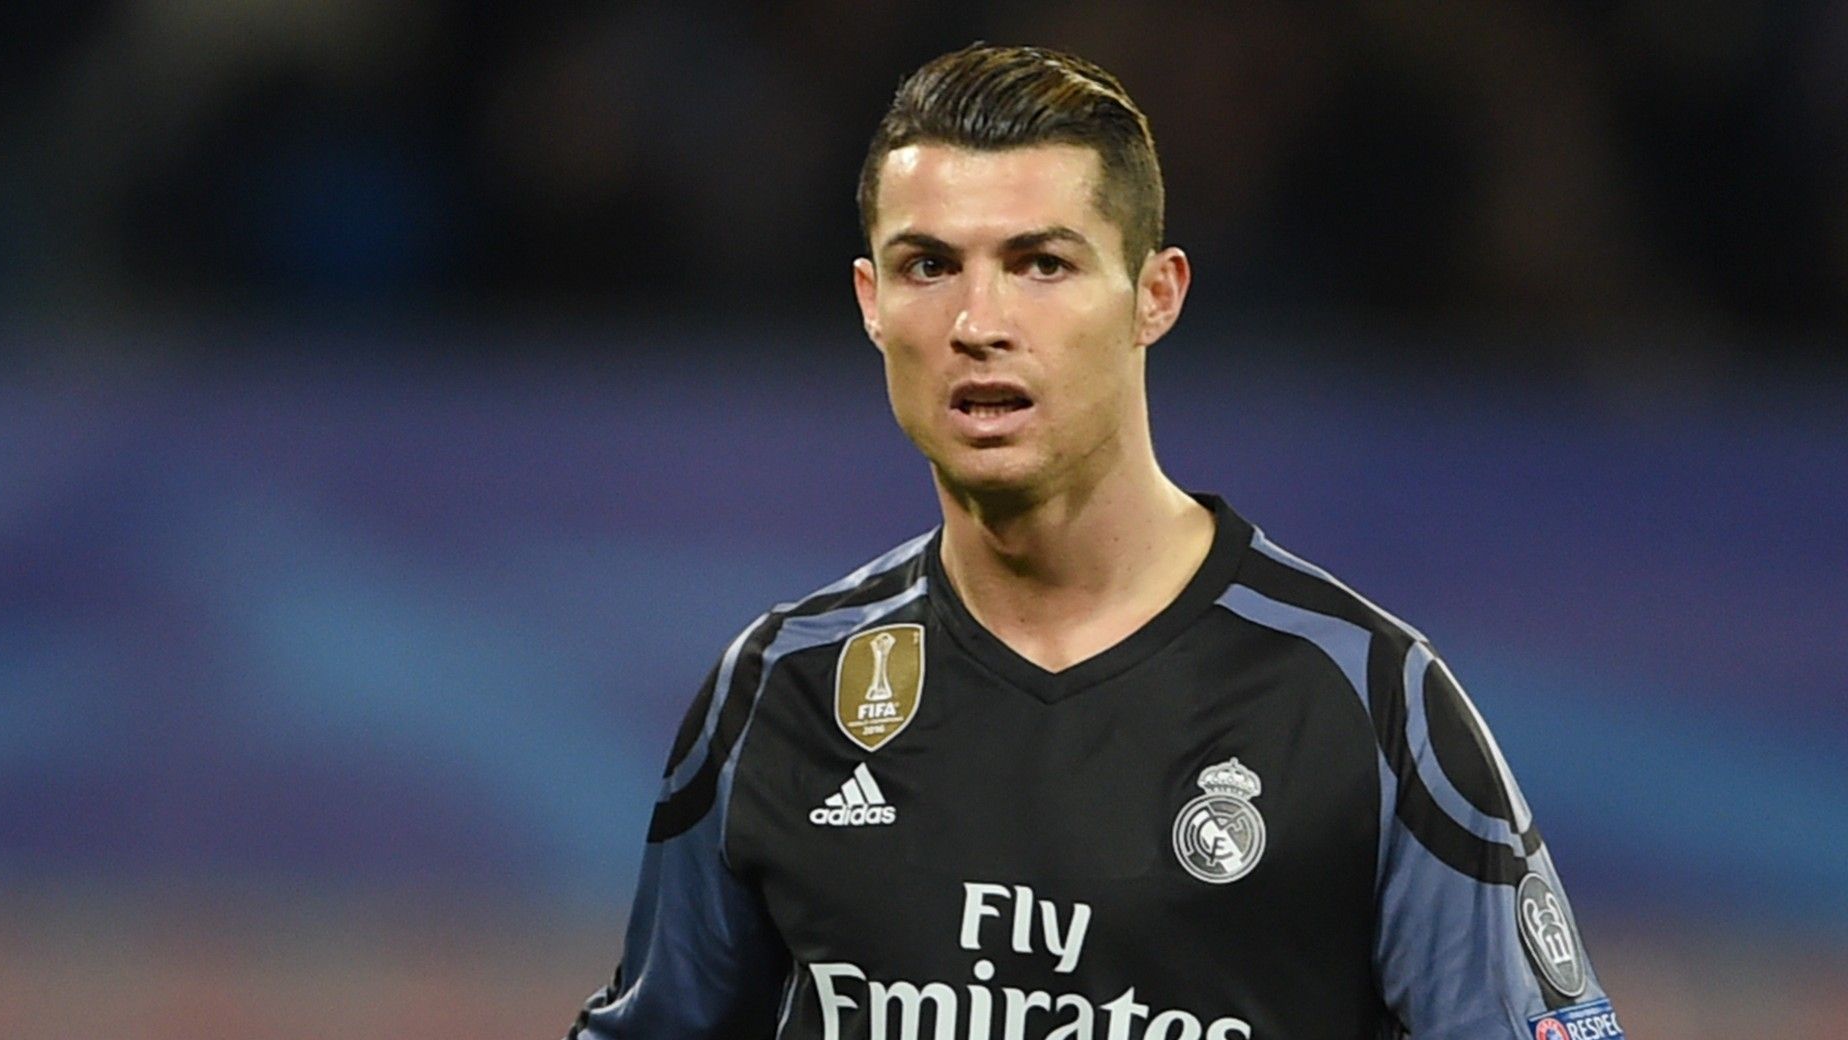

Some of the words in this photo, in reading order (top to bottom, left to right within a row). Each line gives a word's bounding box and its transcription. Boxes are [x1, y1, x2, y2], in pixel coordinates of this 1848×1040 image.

[857, 702, 897, 720] FIFA
[809, 803, 896, 826] adidas
[959, 882, 1091, 973] Fly
